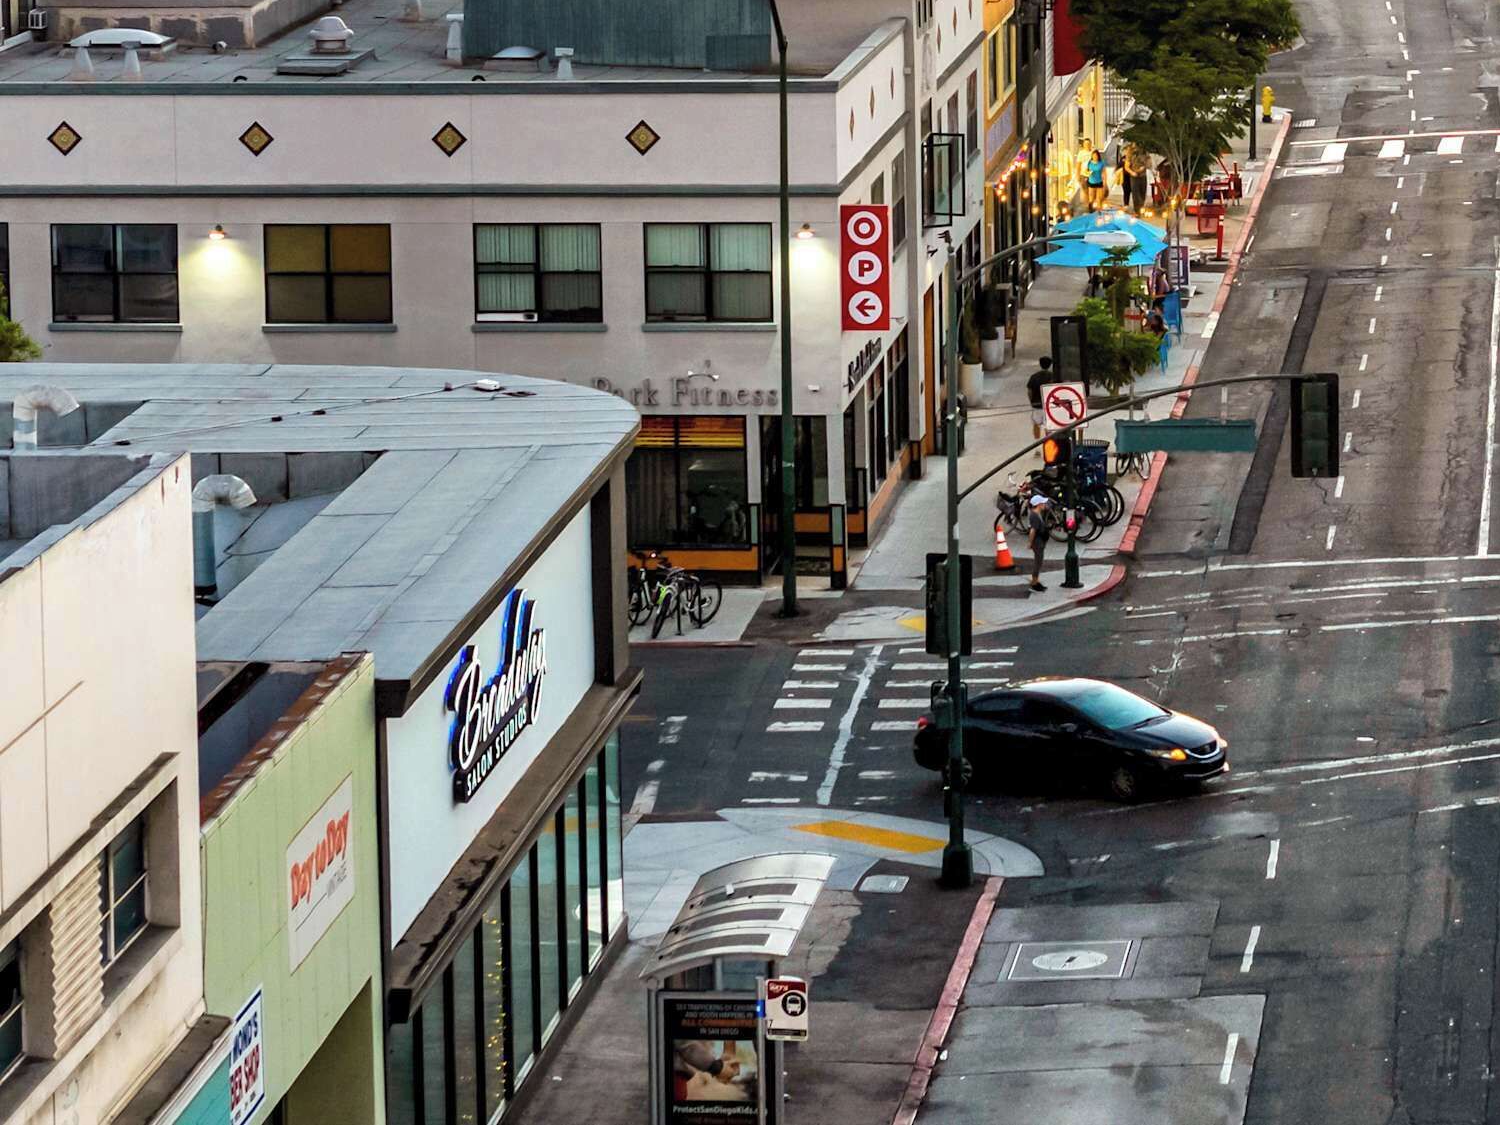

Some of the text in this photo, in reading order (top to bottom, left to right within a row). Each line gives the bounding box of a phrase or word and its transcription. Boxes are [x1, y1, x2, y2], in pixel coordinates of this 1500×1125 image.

[857, 259, 874, 277] P
[671, 376, 779, 407] Fitness
[455, 588, 547, 771] Broadway
[466, 701, 527, 796] SALON STUDIOS
[290, 852, 314, 911] Day
[327, 818, 349, 867] Day
[707, 1027, 719, 1035] SAN
[720, 1027, 739, 1035] DIEGO
